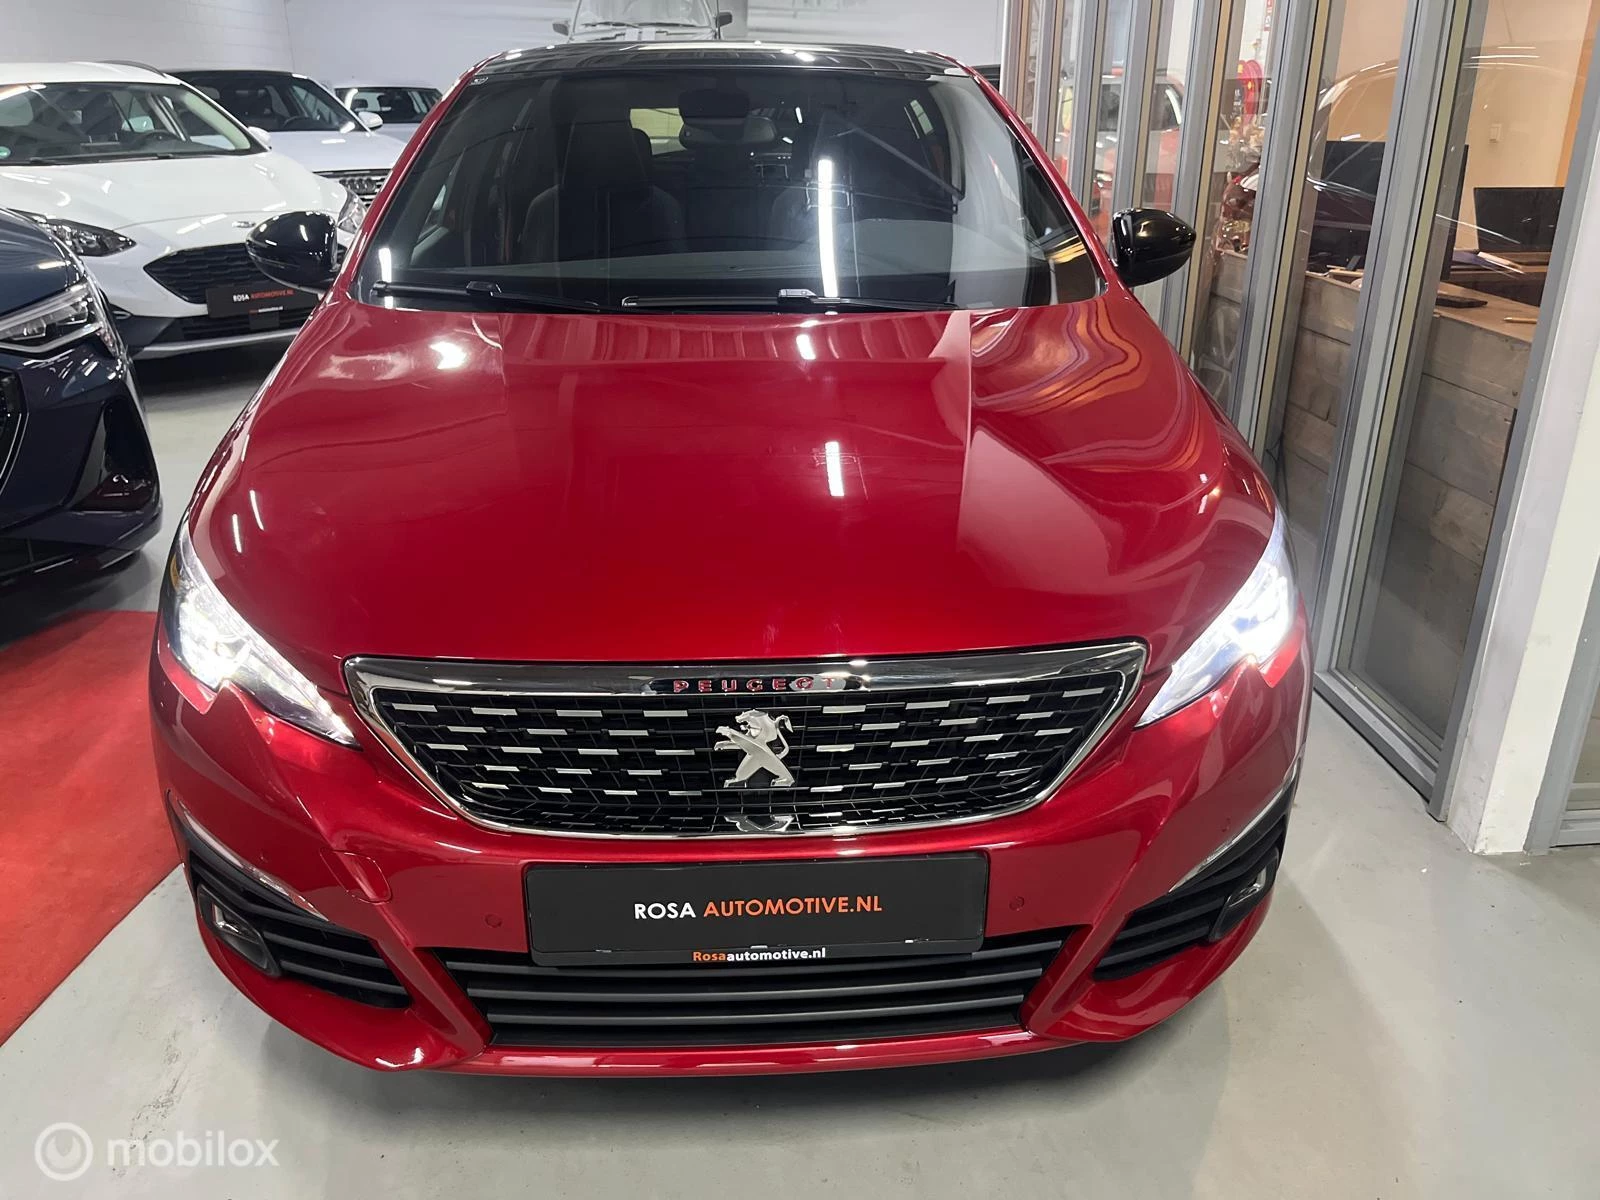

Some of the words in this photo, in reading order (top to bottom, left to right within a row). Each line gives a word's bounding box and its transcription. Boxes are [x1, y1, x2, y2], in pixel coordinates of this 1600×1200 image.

[673, 677, 835, 693] PEUGEOT
[634, 903, 696, 920] ROSA
[703, 895, 883, 918] AUTOMOTIVE.NL
[693, 947, 826, 962] Rosaautomotive.nl
